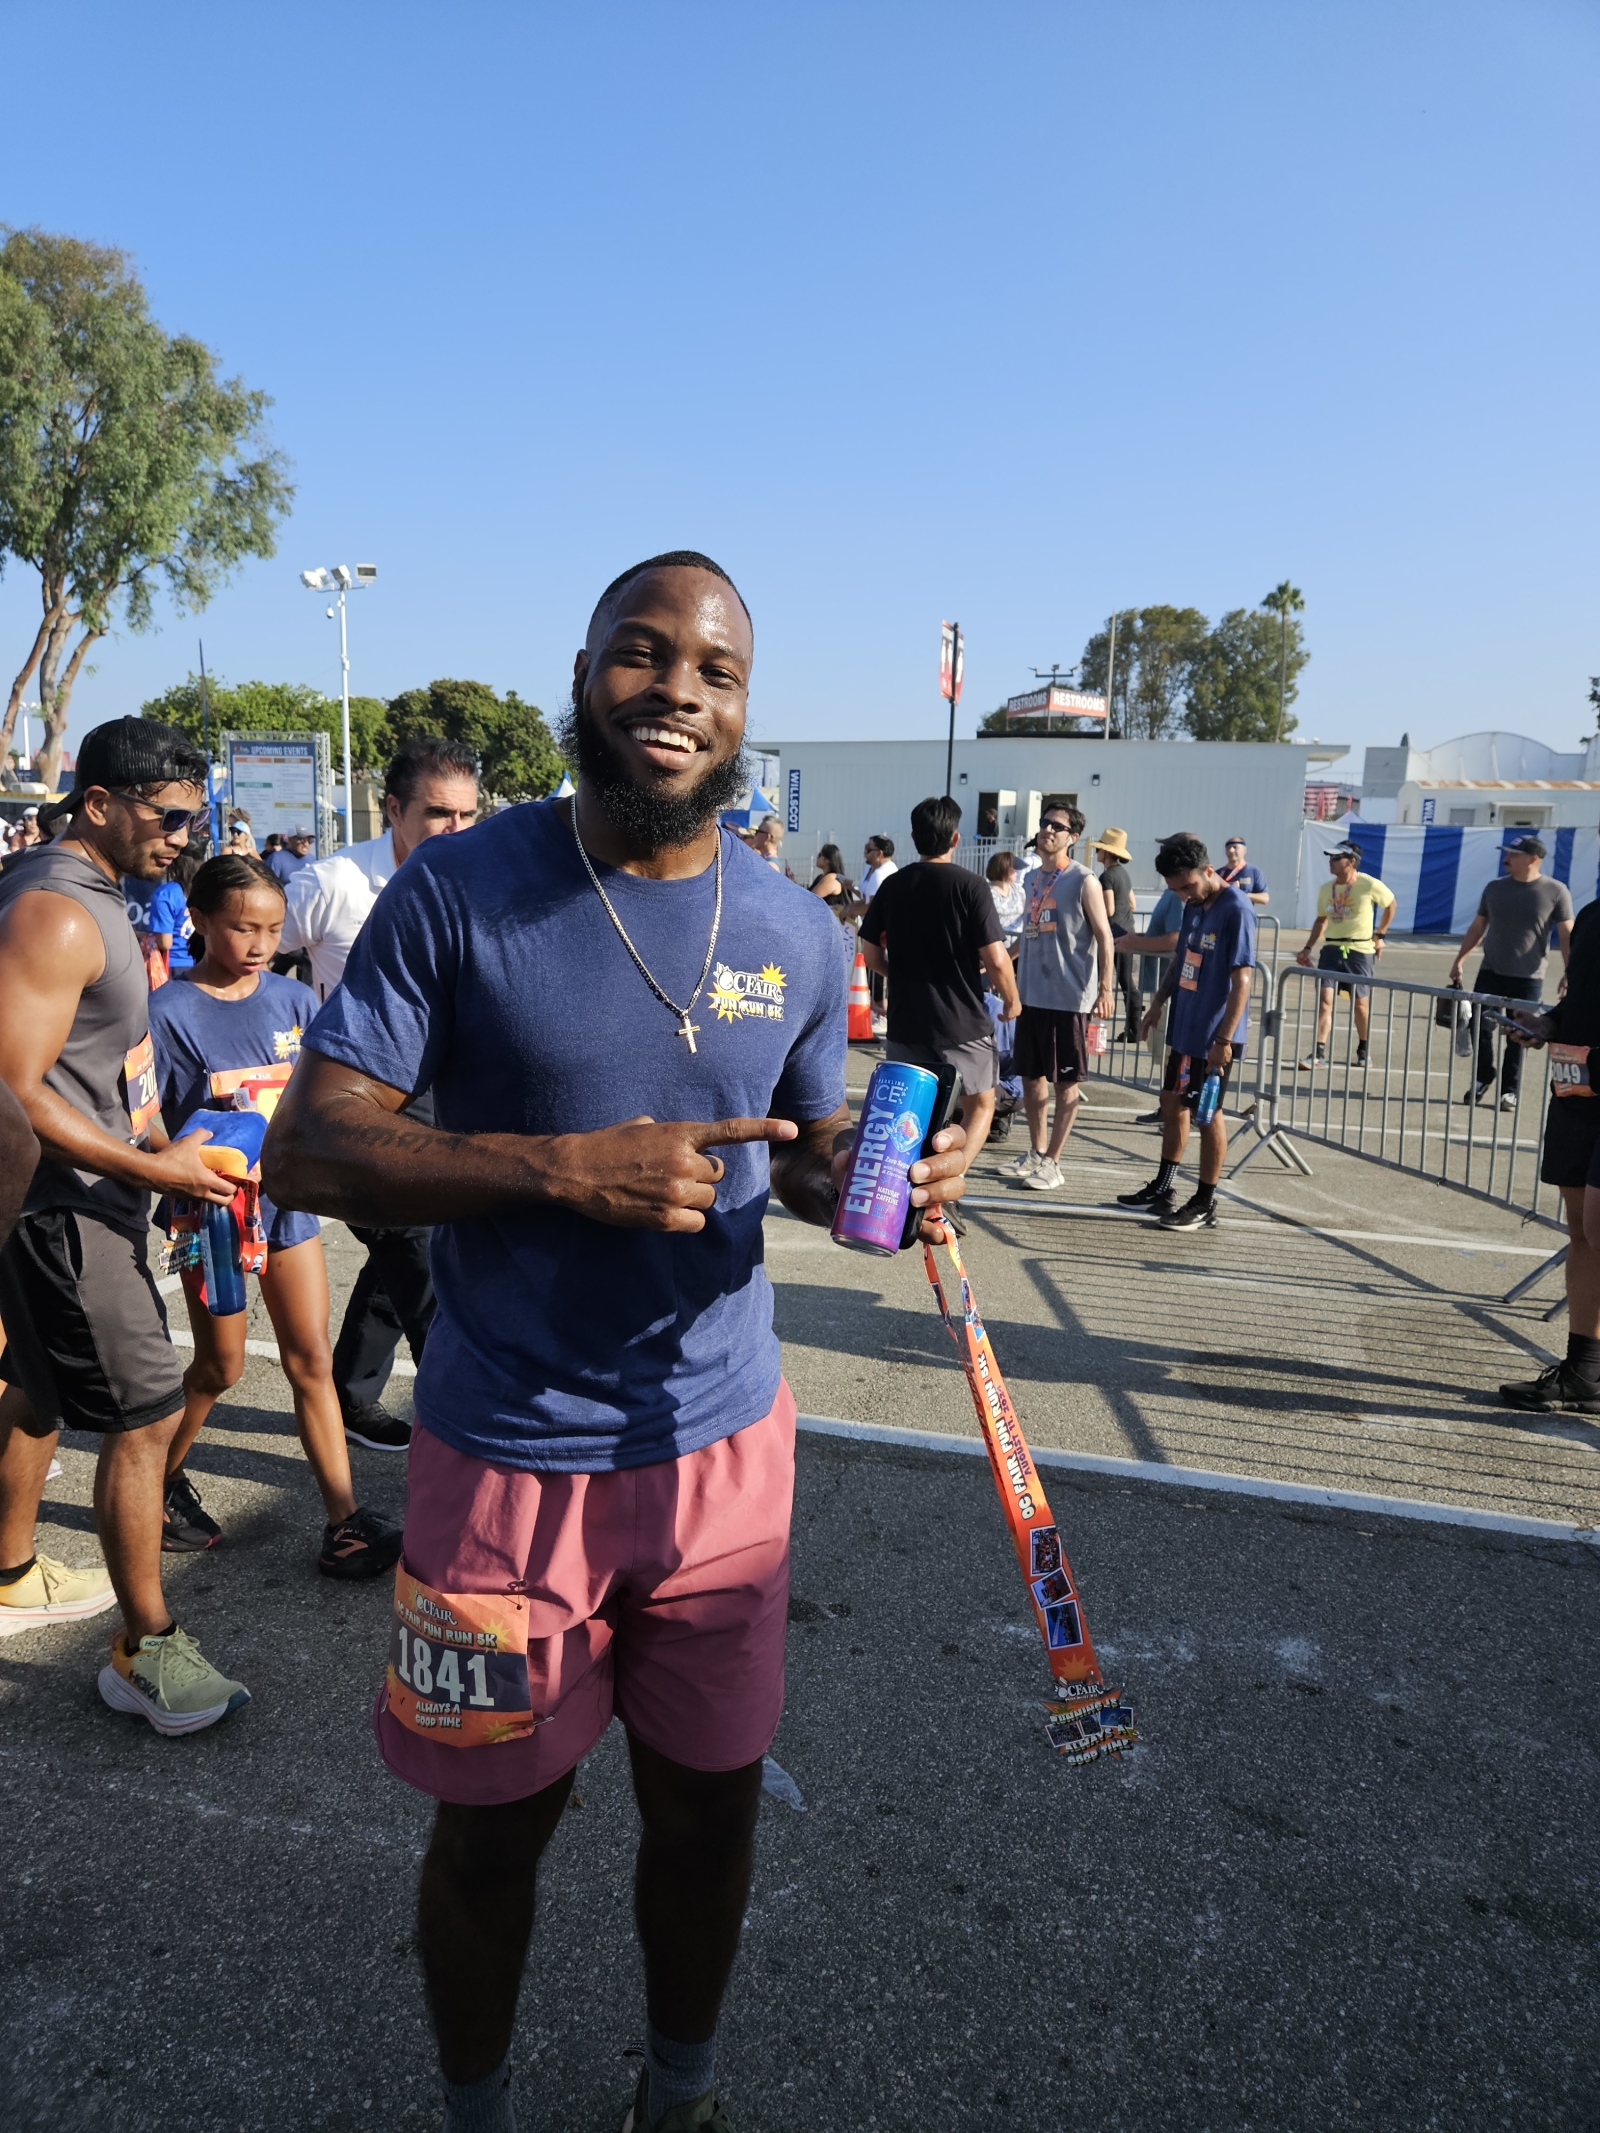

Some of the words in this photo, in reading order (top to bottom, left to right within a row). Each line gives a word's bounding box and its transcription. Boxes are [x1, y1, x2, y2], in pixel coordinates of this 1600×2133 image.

[1008, 692, 1047, 712] RESTROOMS
[1053, 692, 1105, 712] RESTROOMS
[251, 745, 282, 755] UPCOMING
[284, 746, 308, 756] EVENTS
[789, 771, 800, 830] WILLSCOT
[714, 997, 739, 1013] FUN
[740, 1000, 766, 1018] RUN
[767, 1004, 784, 1021] 5K
[872, 1084, 904, 1103] ICE
[844, 1105, 895, 1215] ENERGY
[876, 1193, 899, 1206] CAFFEINE
[877, 1186, 899, 1198] NATURAL
[977, 1350, 989, 1379] 5K
[984, 1379, 1003, 1418] RUN
[995, 1417, 1014, 1453] FUN
[1012, 1434, 1032, 1475] AUGUST
[1006, 1451, 1027, 1494] FAIR
[1018, 1493, 1036, 1520] OC
[405, 1607, 421, 1630] FAIR
[423, 1620, 442, 1641] FUN
[445, 1629, 473, 1646] RUN
[476, 1632, 497, 1648] 5K
[398, 1625, 495, 1707] 1841
[415, 1713, 437, 1728] GOOD
[439, 1716, 462, 1729] TIME
[416, 1701, 451, 1715] ALWAYS
[453, 1703, 462, 1715] A
[1050, 1702, 1103, 1725] RUNNING
[1106, 1698, 1119, 1708] IS
[1067, 1750, 1100, 1766] GOOD
[1101, 1739, 1132, 1755] TIME
